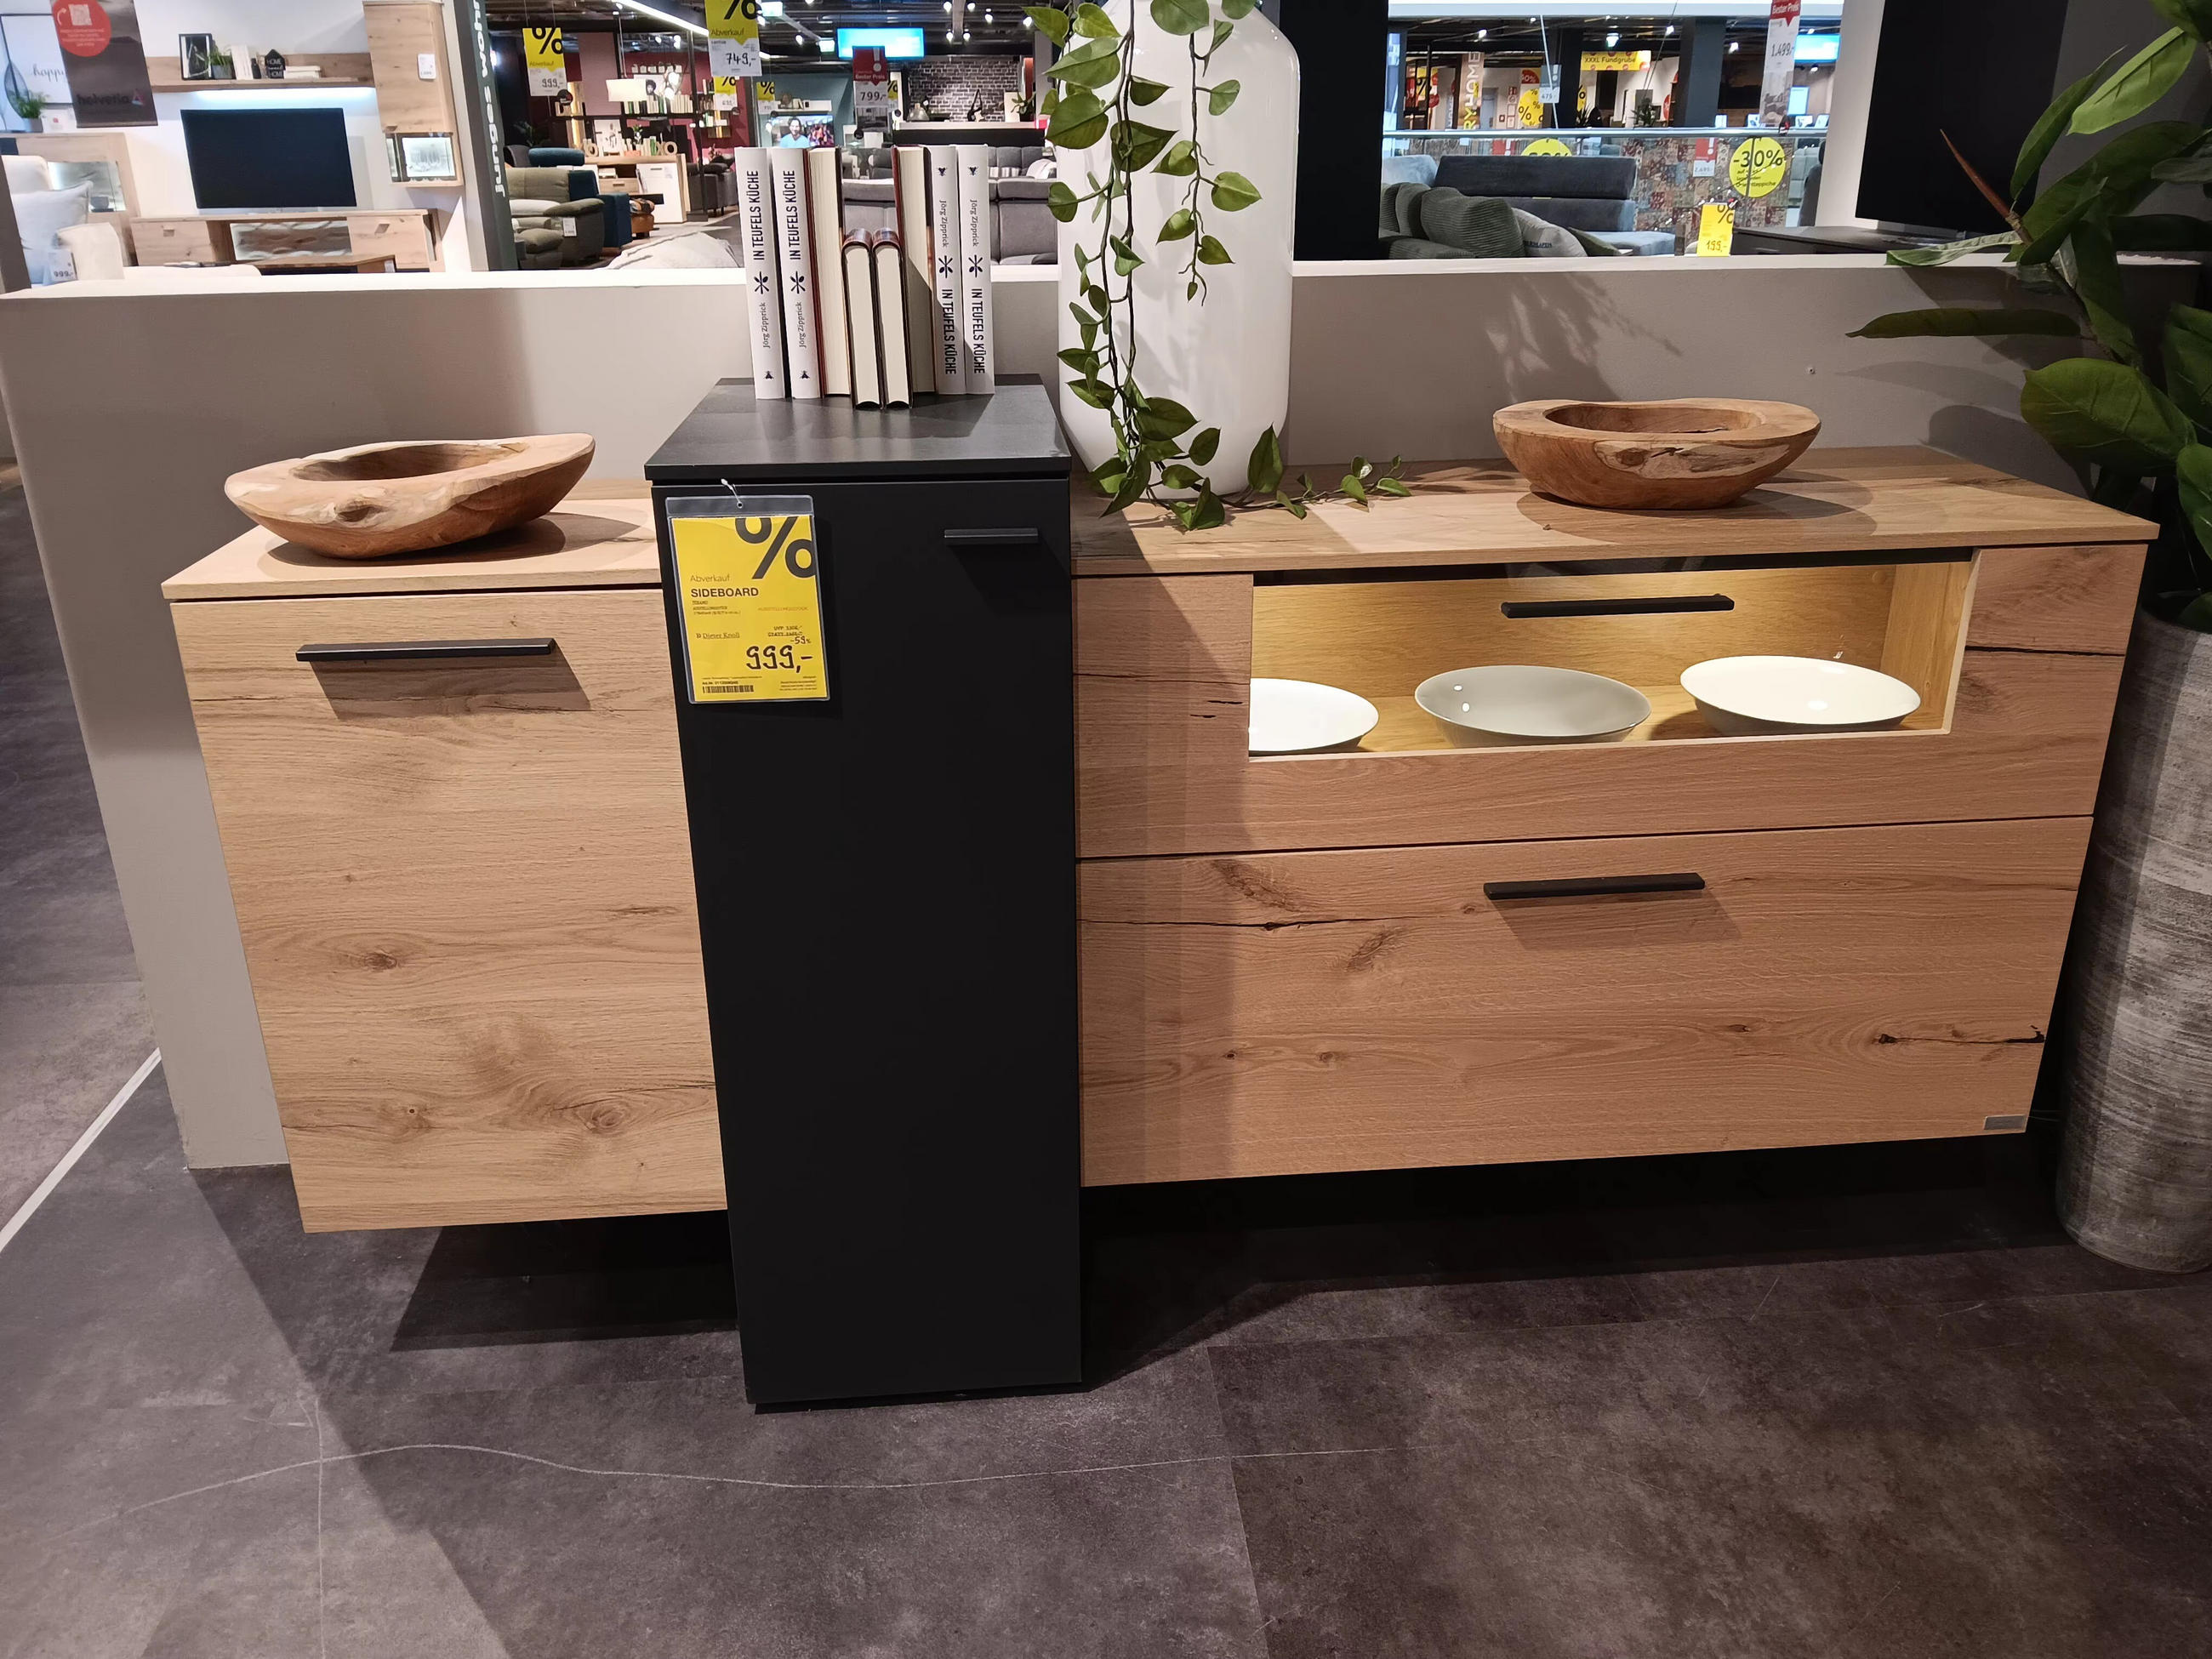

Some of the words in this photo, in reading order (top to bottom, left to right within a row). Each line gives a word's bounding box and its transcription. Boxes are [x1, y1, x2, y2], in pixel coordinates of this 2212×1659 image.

[711, 27, 744, 36] Abverkauf
[726, 53, 756, 66] 749,-
[484, 85, 506, 197] junges
[746, 170, 761, 203] KÜCHE
[783, 170, 797, 203] KÜCHE
[750, 206, 764, 248] TEUFELS
[786, 206, 801, 248] TEUFELS
[940, 217, 949, 248] Zipprick
[970, 216, 979, 247] Zipprick
[753, 250, 766, 260] IN
[790, 250, 801, 260] IN
[942, 289, 953, 299] IN
[972, 288, 983, 298] IN
[759, 302, 769, 332] Zipprick
[795, 302, 805, 332] Zipprick
[942, 302, 955, 341] TEUFELS
[972, 301, 984, 340] TEUFELS
[944, 345, 958, 374] KÜCHE
[973, 344, 987, 373] KÜCHE
[735, 516, 818, 579] %
[690, 573, 730, 582] Abverkauf
[691, 588, 759, 597] SIDEBOARD
[746, 645, 812, 673] 999,-
